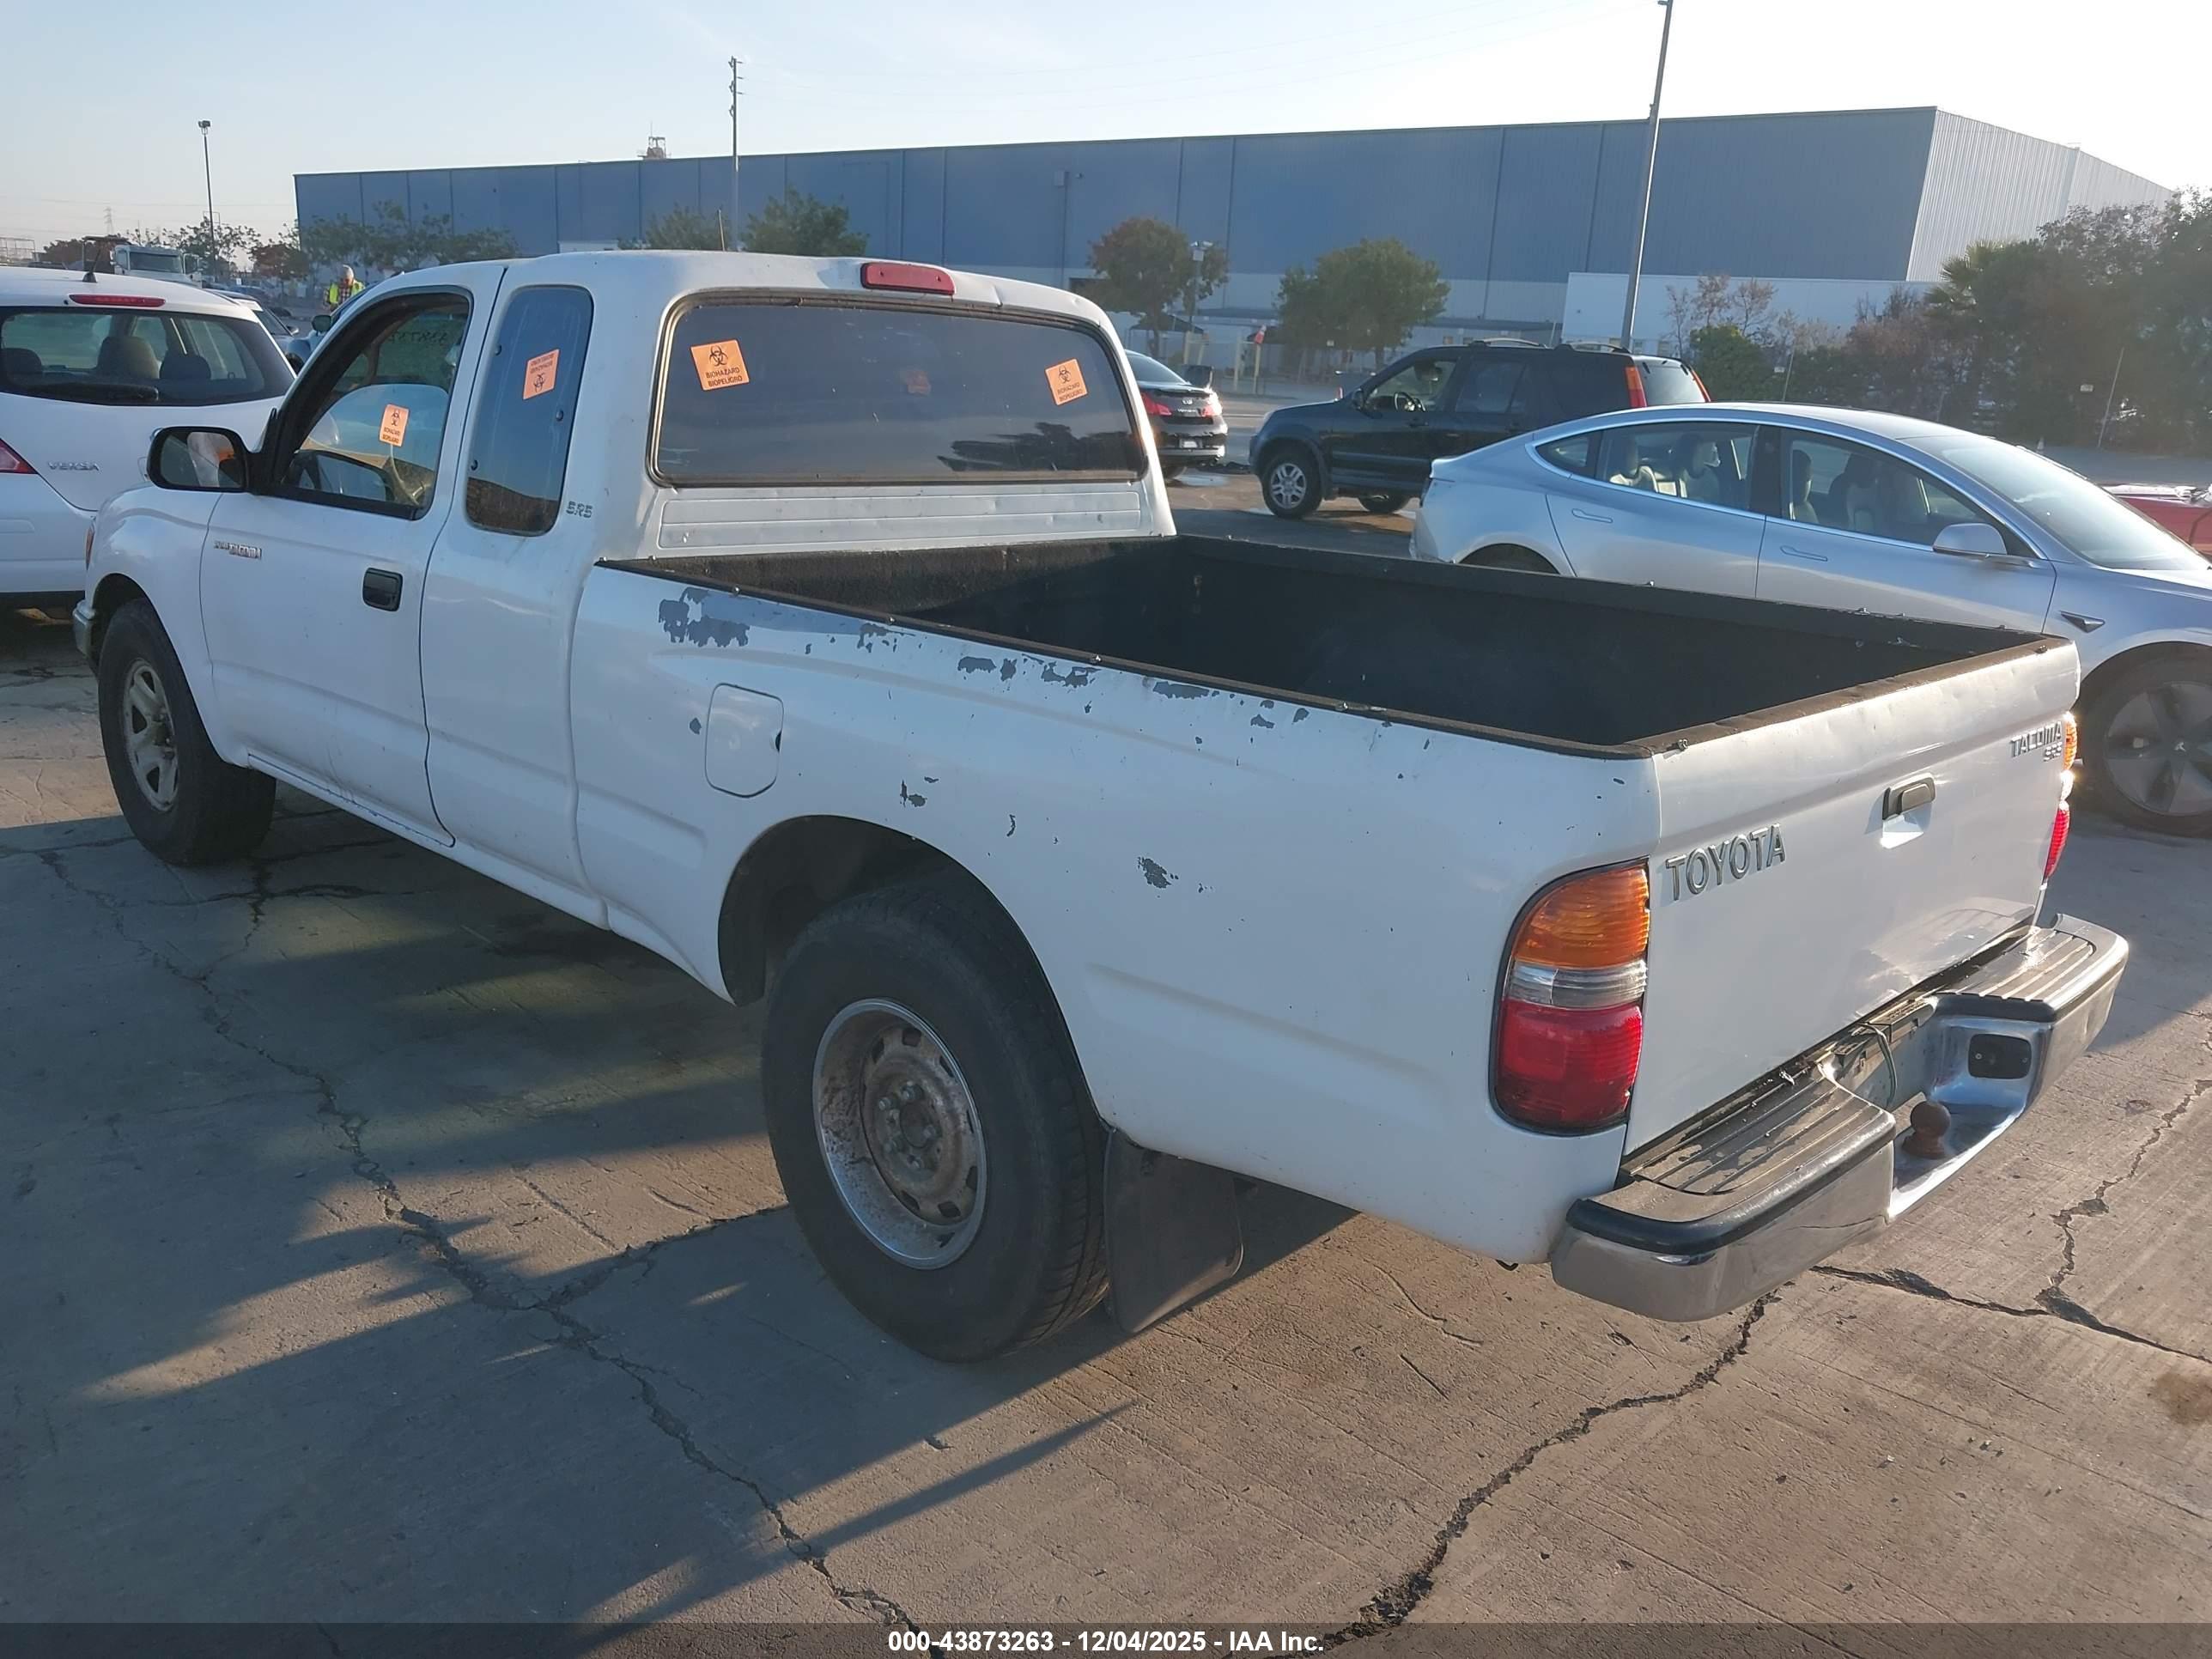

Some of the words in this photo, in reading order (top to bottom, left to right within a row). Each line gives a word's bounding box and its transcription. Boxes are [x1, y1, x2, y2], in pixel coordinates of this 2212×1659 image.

[705, 367, 741, 379] BIOHAZARD
[708, 375, 743, 387] BIOPELIGRO
[47, 462, 100, 471] VERSA
[2009, 721, 2062, 757] TACOMA
[1665, 823, 1786, 902] TOYOTA
